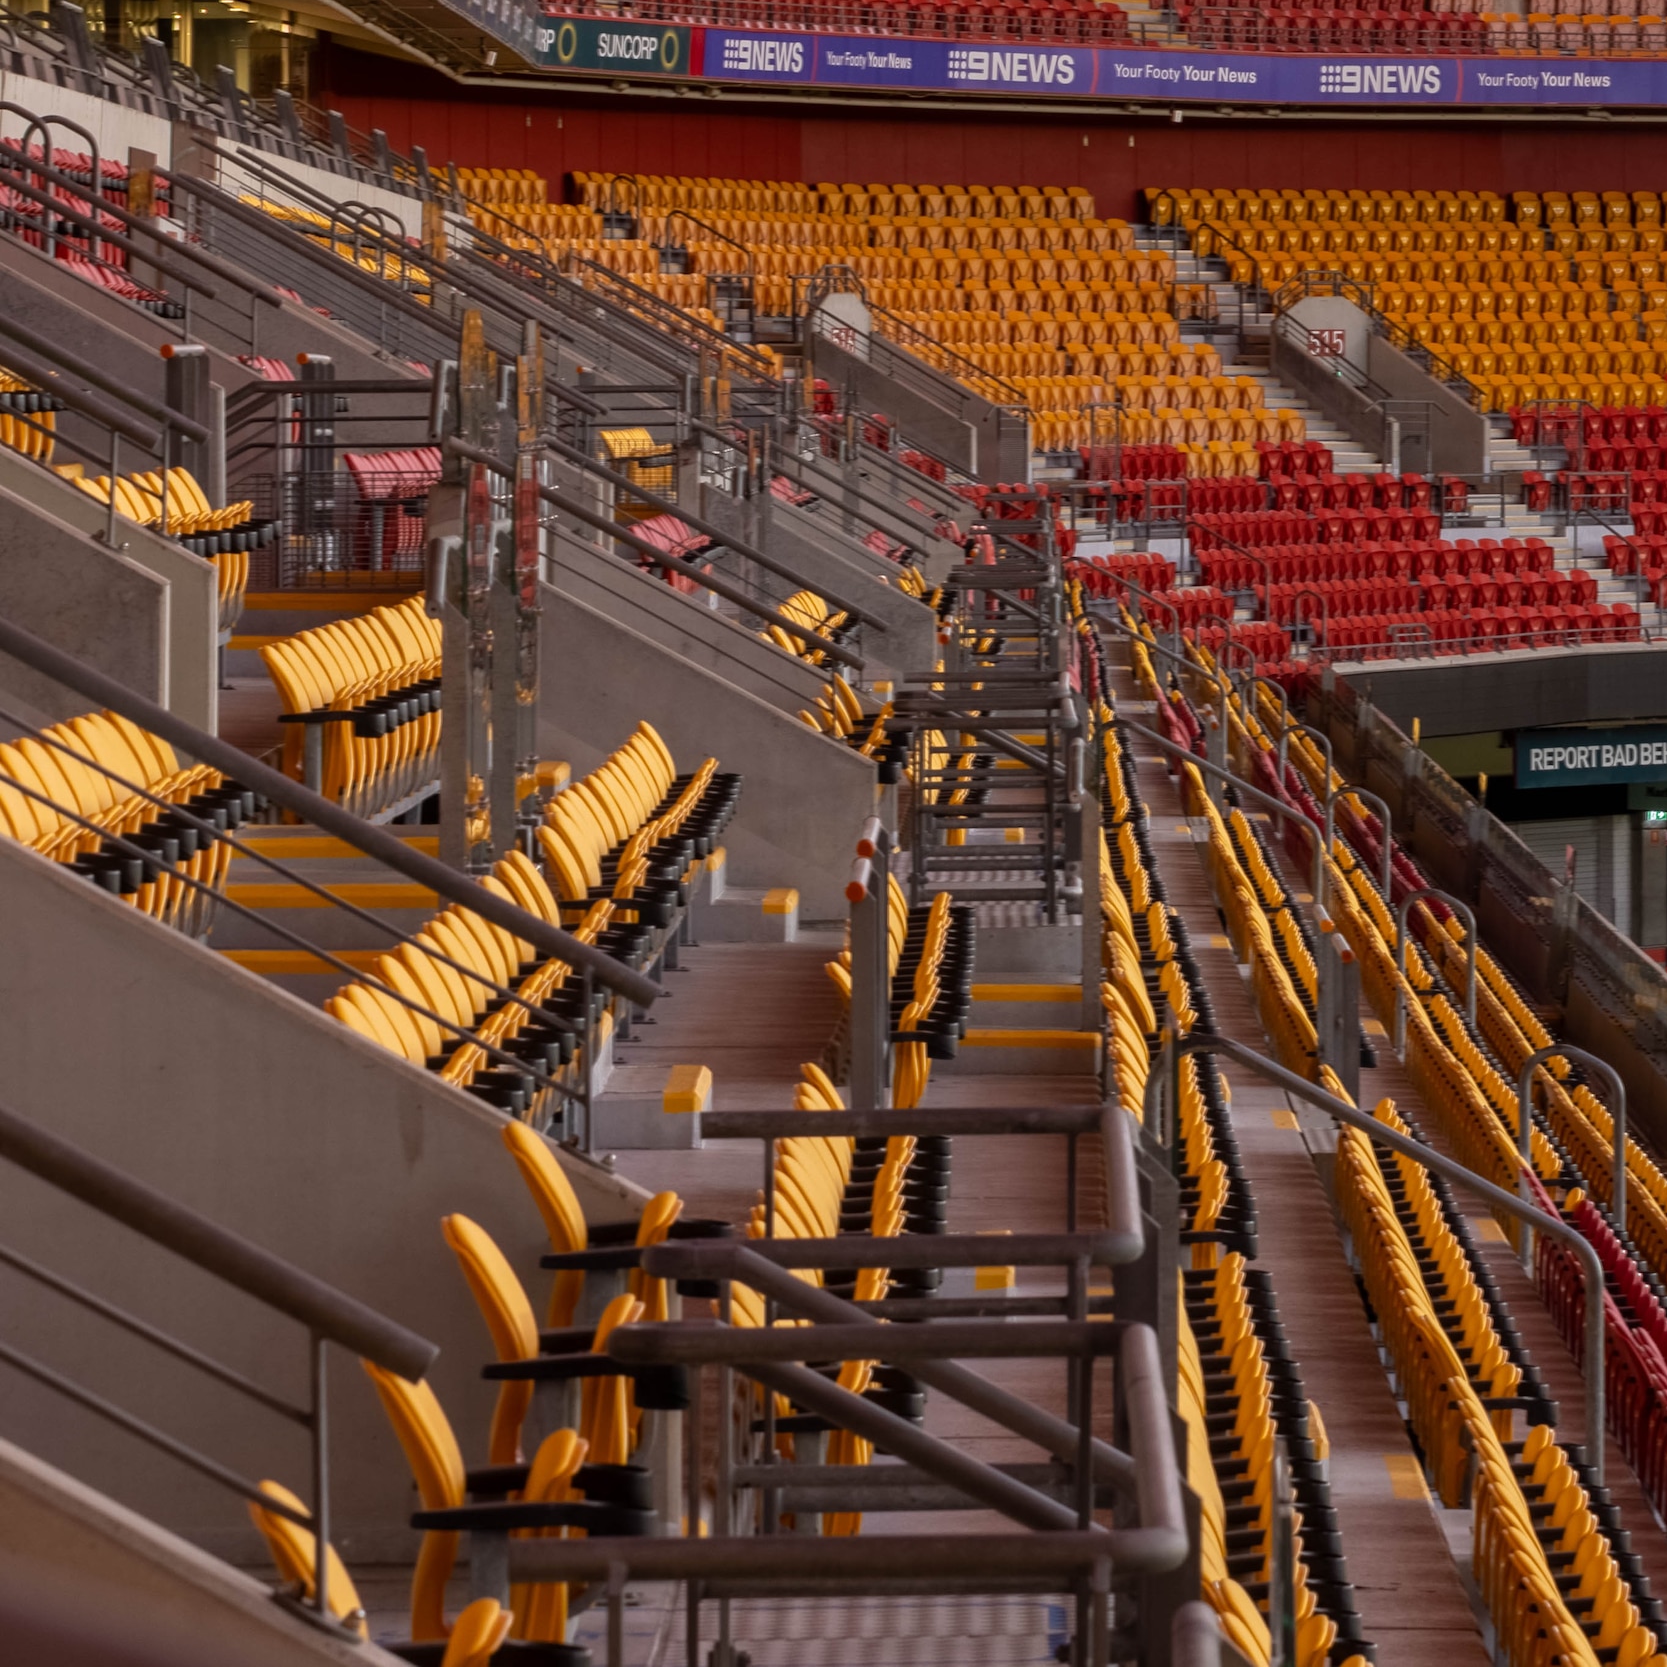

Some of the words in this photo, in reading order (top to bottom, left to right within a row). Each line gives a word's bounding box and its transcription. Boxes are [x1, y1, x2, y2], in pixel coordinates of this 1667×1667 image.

[597, 33, 658, 59] SUNCORP
[827, 51, 845, 65] Your
[844, 52, 866, 69] Footy
[868, 52, 888, 67] Your
[887, 53, 911, 69] News
[1115, 64, 1143, 77] Your
[1146, 65, 1180, 82] Footy
[1183, 66, 1215, 81] Your
[1218, 67, 1256, 83] News
[1478, 73, 1504, 86] Your
[1507, 73, 1538, 89] Footy
[1542, 72, 1571, 86] Your
[1574, 73, 1610, 87] News
[1310, 330, 1343, 355] 515
[1529, 745, 1598, 771] REPORT
[1600, 743, 1637, 767] BAD
